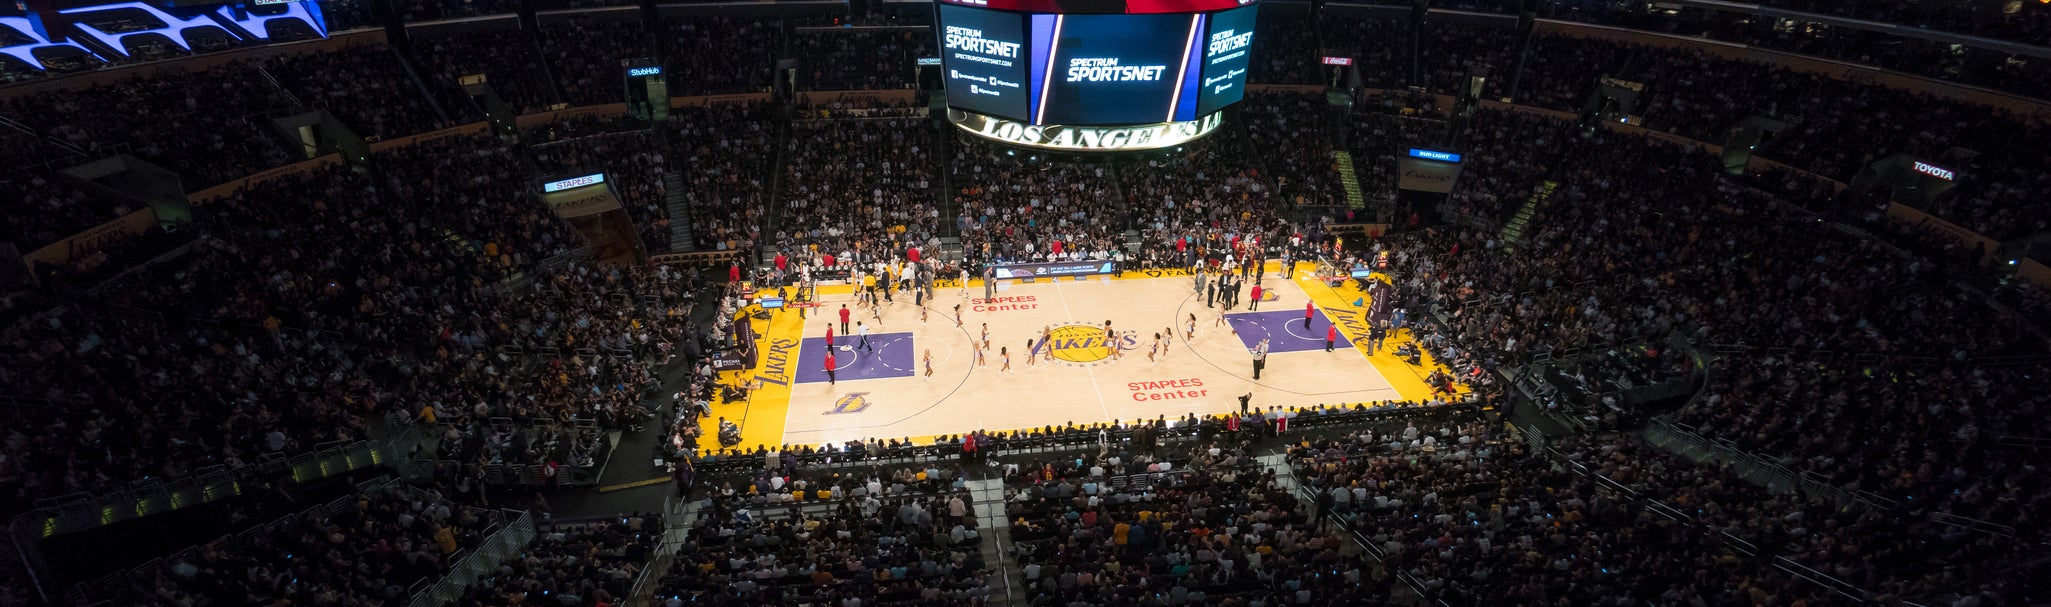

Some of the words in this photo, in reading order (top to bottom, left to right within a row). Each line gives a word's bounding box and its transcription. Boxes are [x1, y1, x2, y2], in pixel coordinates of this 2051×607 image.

[946, 25, 982, 38] SPECTRUM
[1211, 29, 1234, 42] SPECTRUM
[946, 33, 1020, 58] SPORTSNET
[1207, 31, 1253, 57] SPORTSNET
[1070, 58, 1119, 67] SPECTRUM
[631, 67, 659, 76] StubHub
[1066, 65, 1166, 82] SPORTSNET
[980, 118, 1045, 145] LOS
[1047, 119, 1199, 149] ANGELES
[1914, 161, 1953, 181] TOYOTA
[556, 176, 593, 189] STAPLES
[973, 303, 1038, 312] Center
[753, 336, 799, 388] LAKERS
[1127, 377, 1204, 391] STAPLES
[1132, 389, 1208, 402] Center
